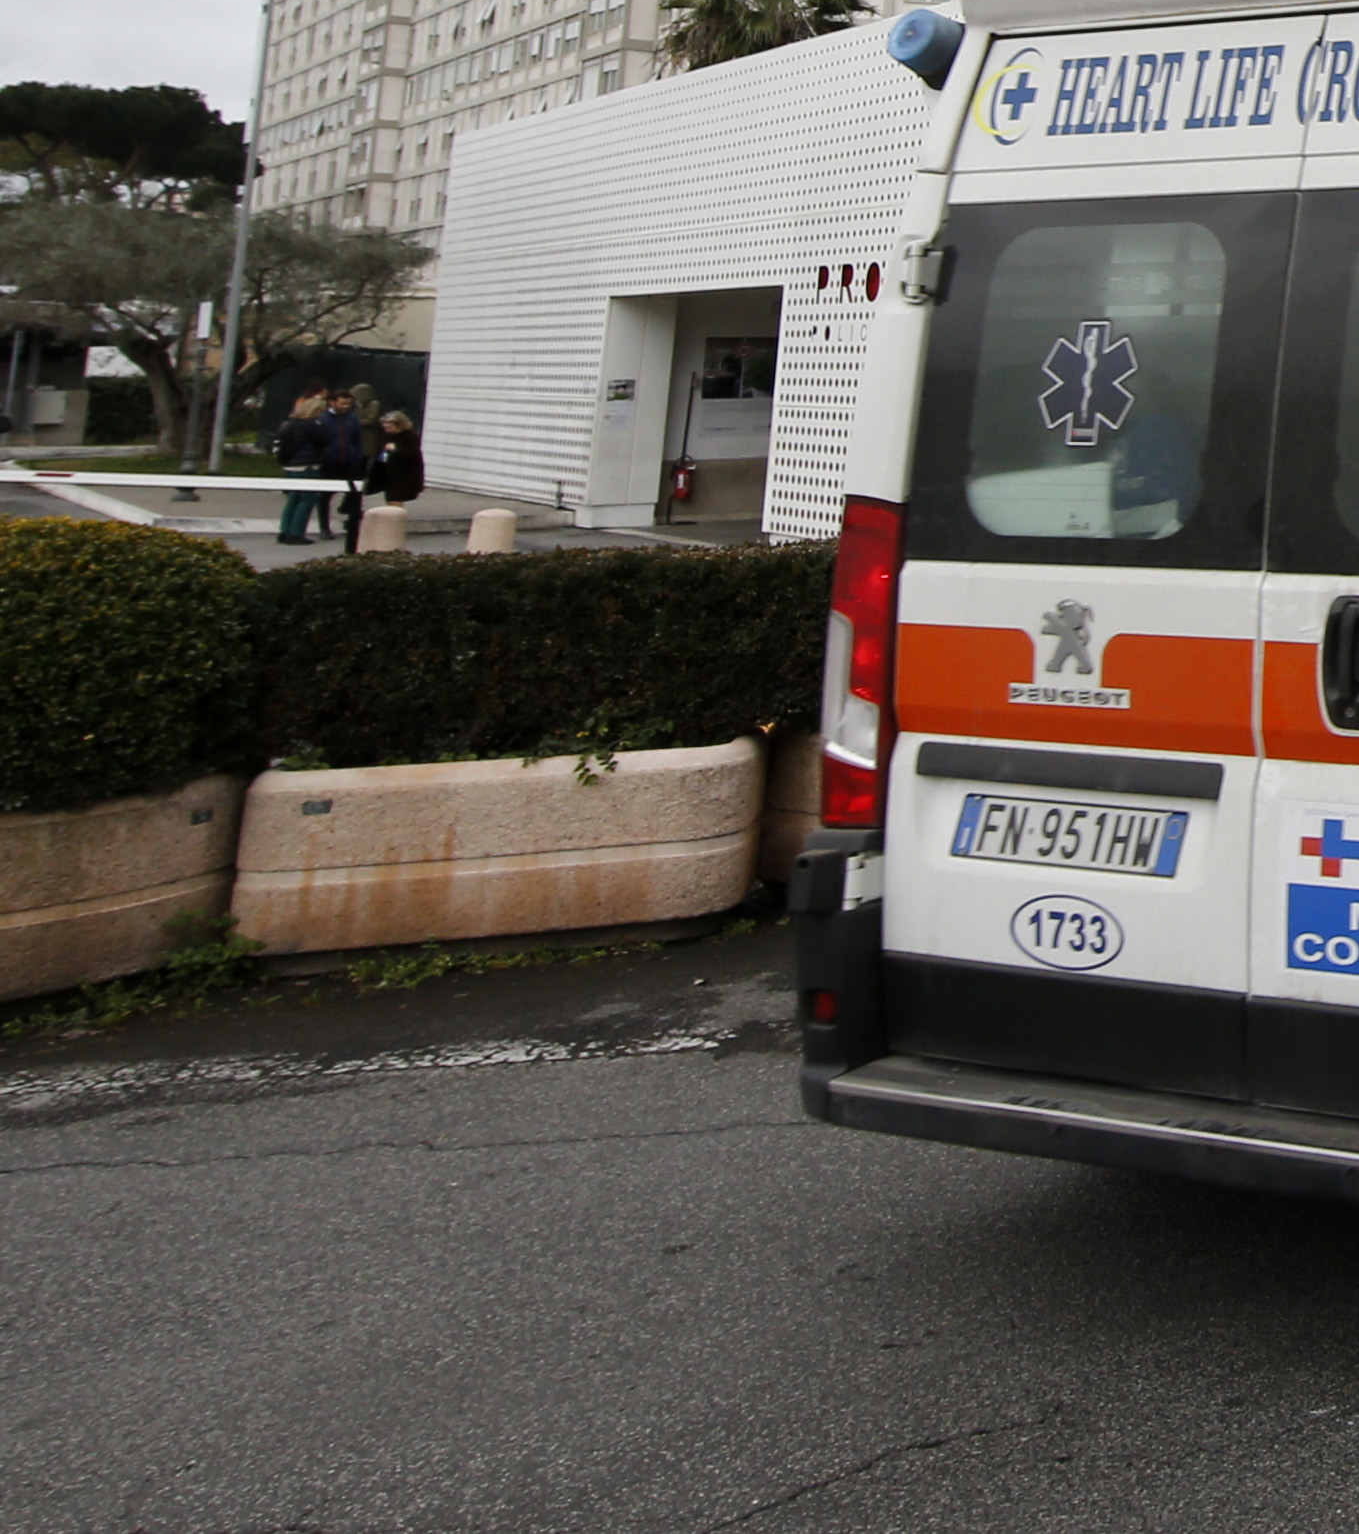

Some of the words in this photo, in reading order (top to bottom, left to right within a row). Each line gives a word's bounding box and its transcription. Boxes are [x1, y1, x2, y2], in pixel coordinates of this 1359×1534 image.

[1046, 51, 1183, 137] HEART
[1183, 44, 1286, 130] LIFE
[1009, 687, 1128, 707] PEUGEOT
[976, 802, 1029, 856] FN
[1037, 807, 1161, 868] 951HW
[1028, 909, 1109, 955] 1733
